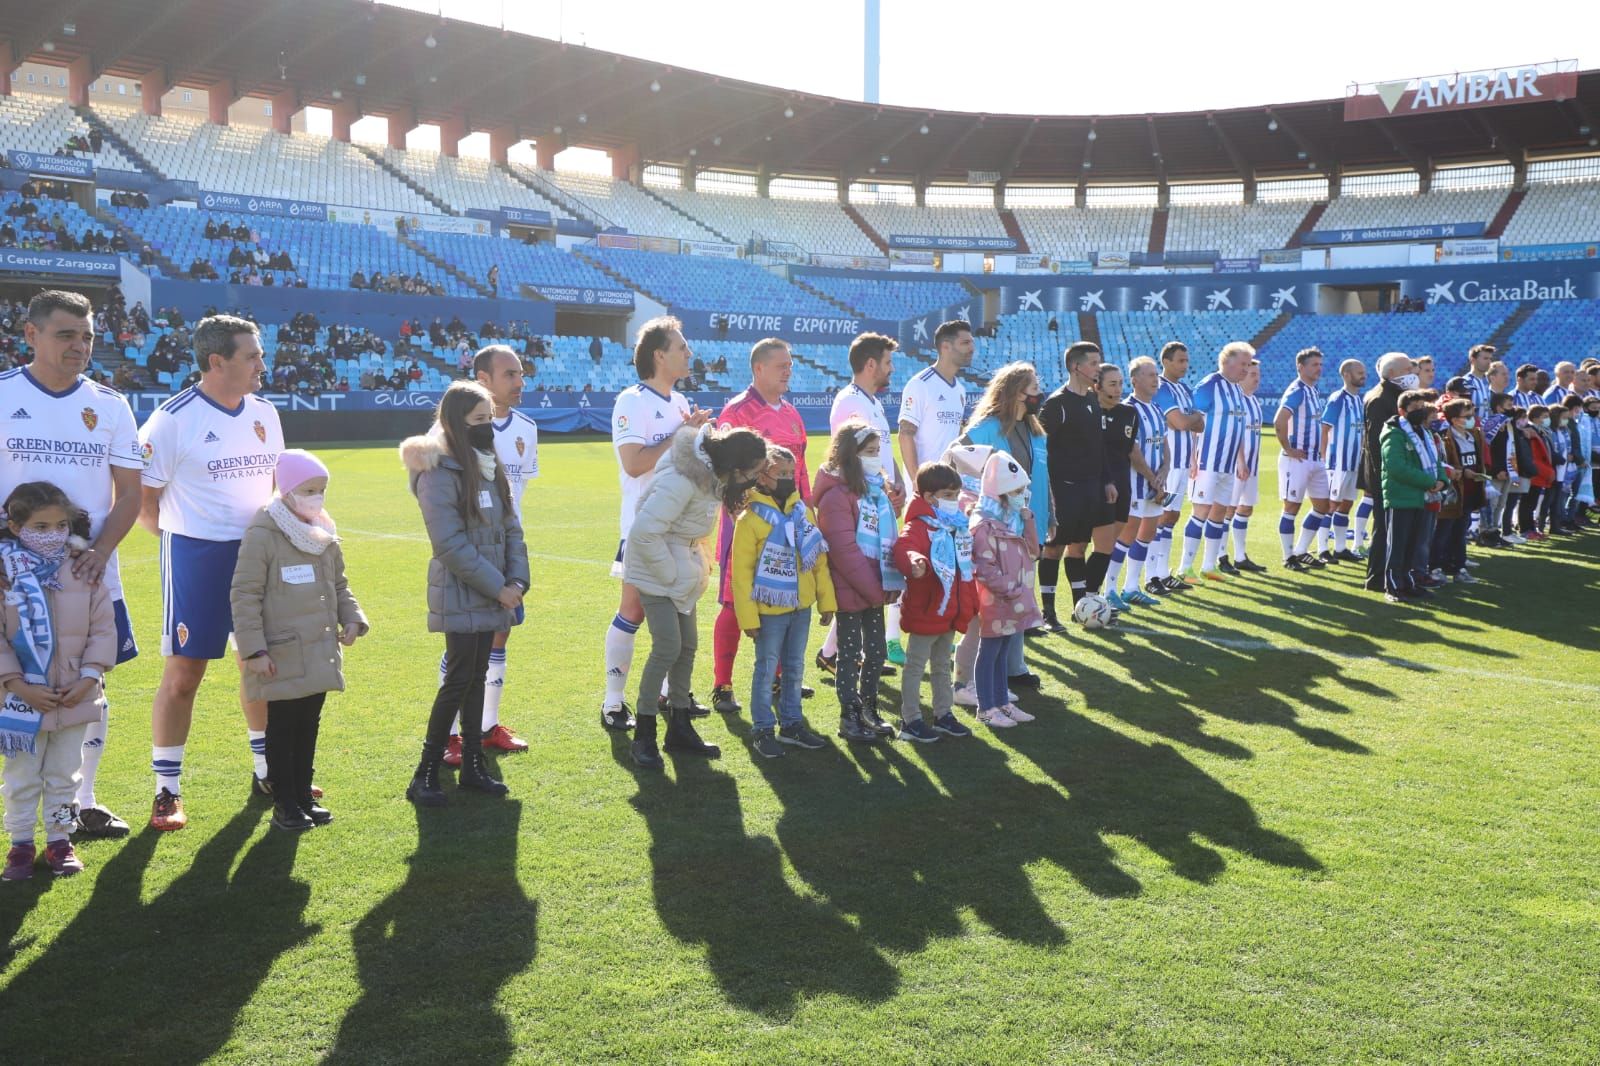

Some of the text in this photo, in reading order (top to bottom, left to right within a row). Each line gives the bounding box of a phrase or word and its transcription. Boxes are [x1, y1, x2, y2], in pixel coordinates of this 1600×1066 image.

[1411, 68, 1543, 110] AMBAR
[36, 156, 88, 168] AUTOMOCIÓN
[40, 163, 86, 175] ARAGONESA
[215, 196, 241, 206] ARPA
[259, 201, 284, 211] ARPA
[300, 206, 324, 215] ARPA
[895, 236, 926, 244] avanza
[978, 239, 1009, 247] avanza
[1361, 227, 1433, 241] elektraaragón
[7, 254, 53, 266] Center
[56, 257, 116, 271] Zaragoza
[1459, 278, 1577, 303] CaixaBank
[793, 317, 859, 334] EXPOTYRE
[12, 453, 103, 468] PHARMACIE
